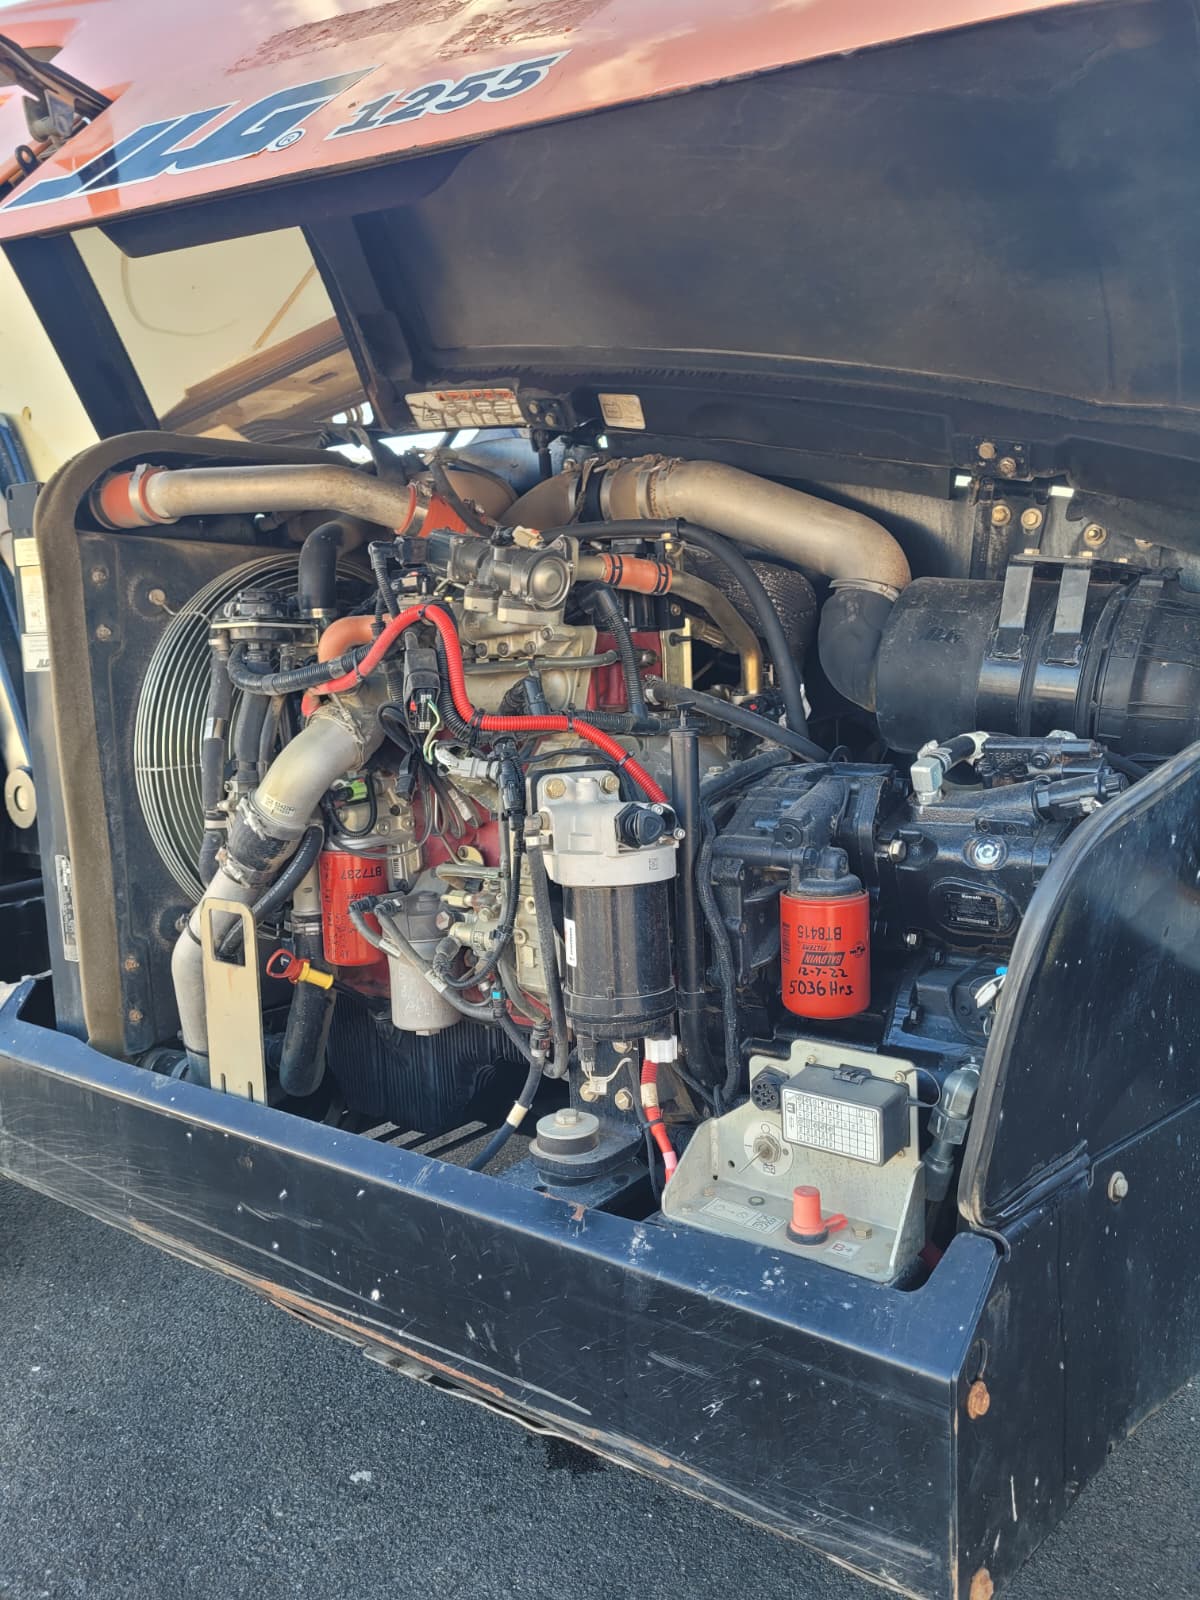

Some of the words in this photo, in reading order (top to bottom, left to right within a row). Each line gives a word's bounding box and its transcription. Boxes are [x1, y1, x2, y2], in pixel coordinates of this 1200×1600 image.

[324, 50, 573, 141] 1255
[797, 925, 842, 941] BT8415
[804, 953, 843, 965] BALDWIN
[789, 980, 826, 996] 5036
[829, 981, 854, 996] Hrs
